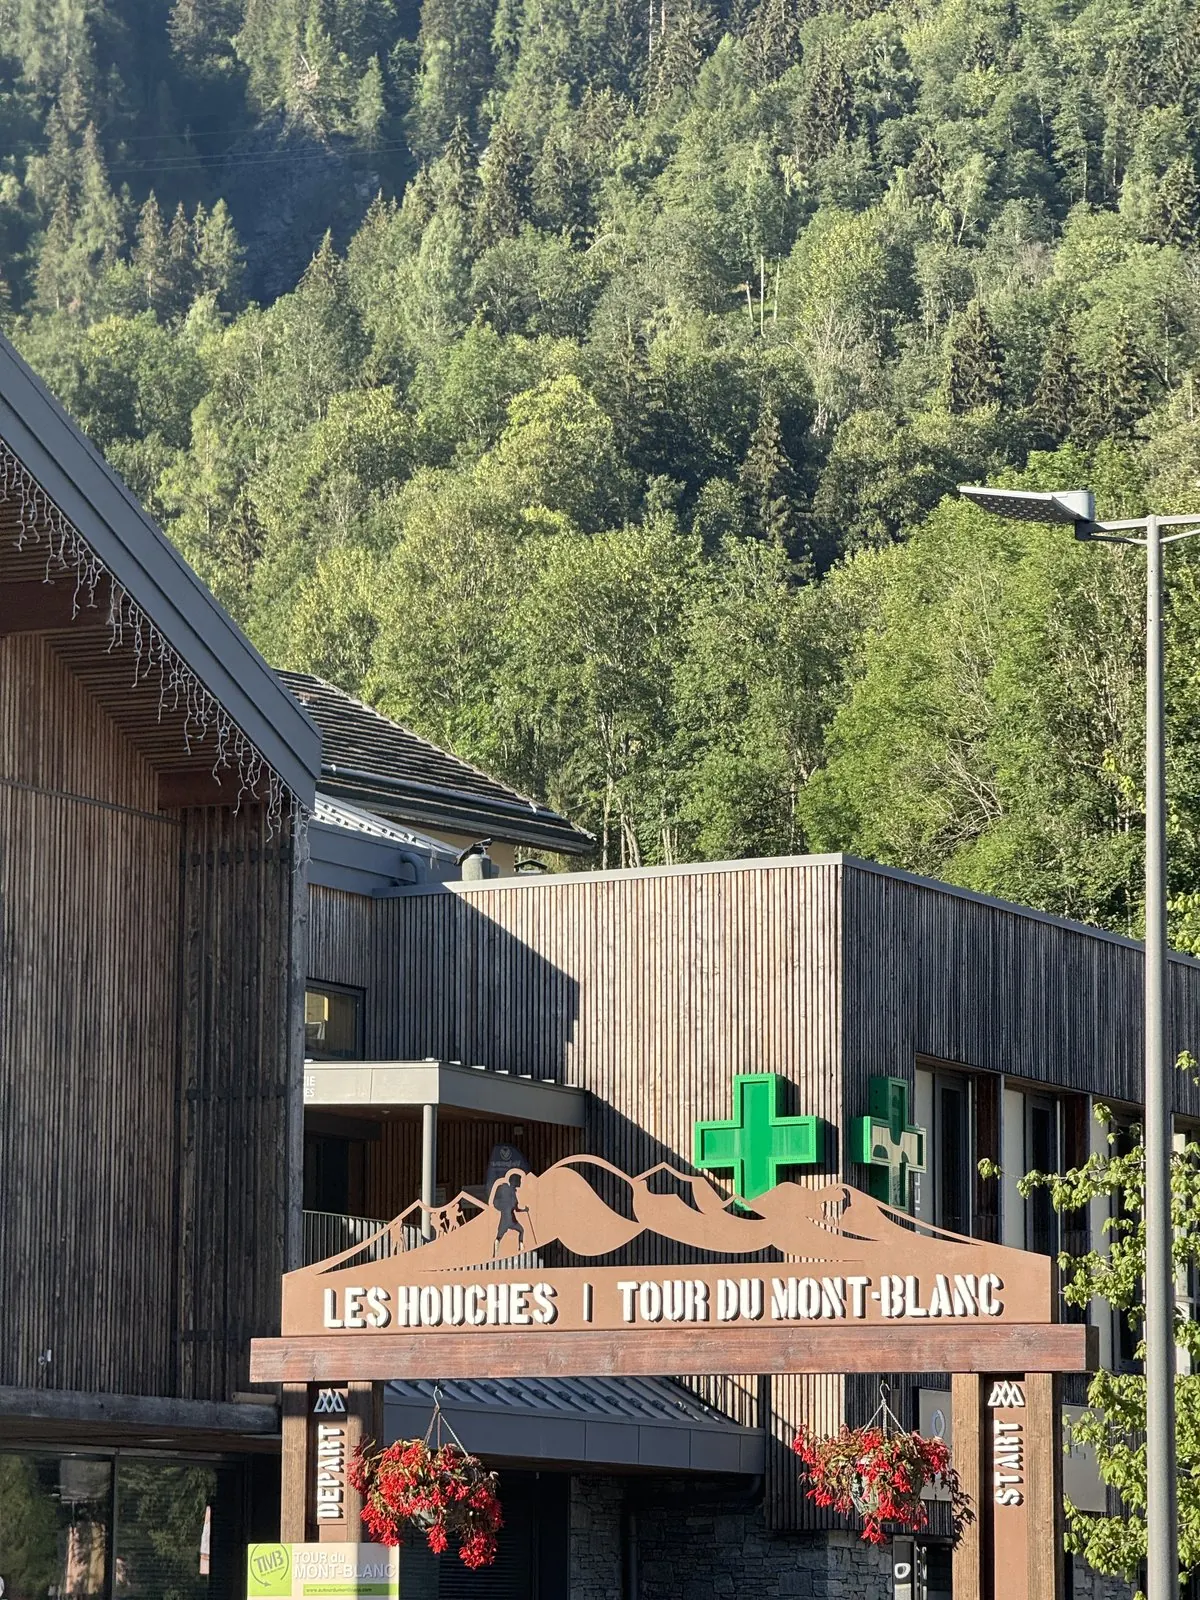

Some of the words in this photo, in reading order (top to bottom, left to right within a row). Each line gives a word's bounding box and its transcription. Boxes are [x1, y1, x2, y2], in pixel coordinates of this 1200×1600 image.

[322, 1286, 391, 1329] LES
[398, 1281, 558, 1329] HOUCHES
[617, 1279, 708, 1324] TOUR
[716, 1277, 762, 1322] DU
[771, 1273, 1004, 1321] MONT-BLANC
[318, 1424, 345, 1520] DEPART
[994, 1419, 1022, 1506] START
[253, 1550, 284, 1573] TMB
[294, 1551, 329, 1564] TOUR
[331, 1551, 346, 1563] du
[294, 1562, 397, 1580] MONT-BLANC
